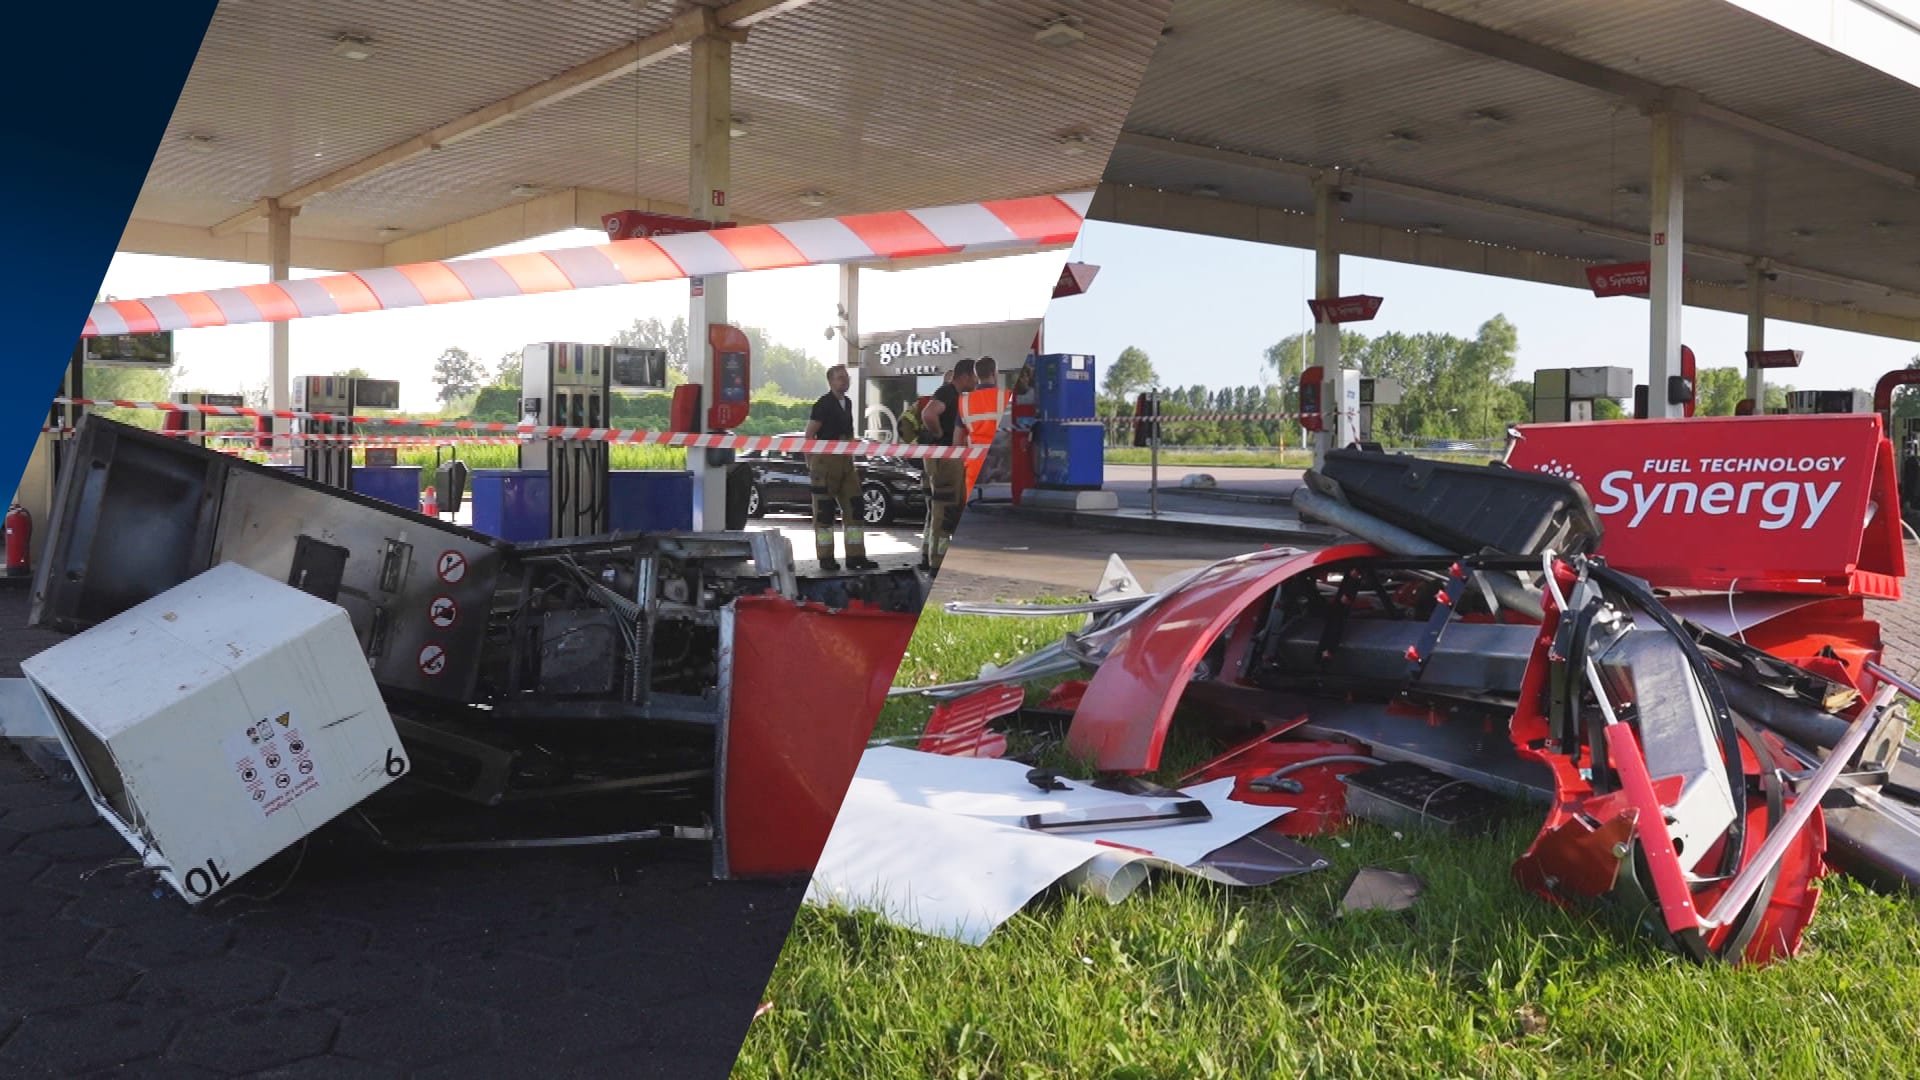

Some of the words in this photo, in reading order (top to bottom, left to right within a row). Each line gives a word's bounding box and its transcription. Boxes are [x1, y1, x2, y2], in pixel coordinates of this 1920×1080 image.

[879, 341, 902, 365] go
[906, 331, 953, 357] fresh
[895, 365, 937, 375] BAKERY
[1642, 458, 1693, 474] FUEL
[1699, 456, 1847, 473] TECHNOLOGY
[1594, 469, 1842, 530] Synergy
